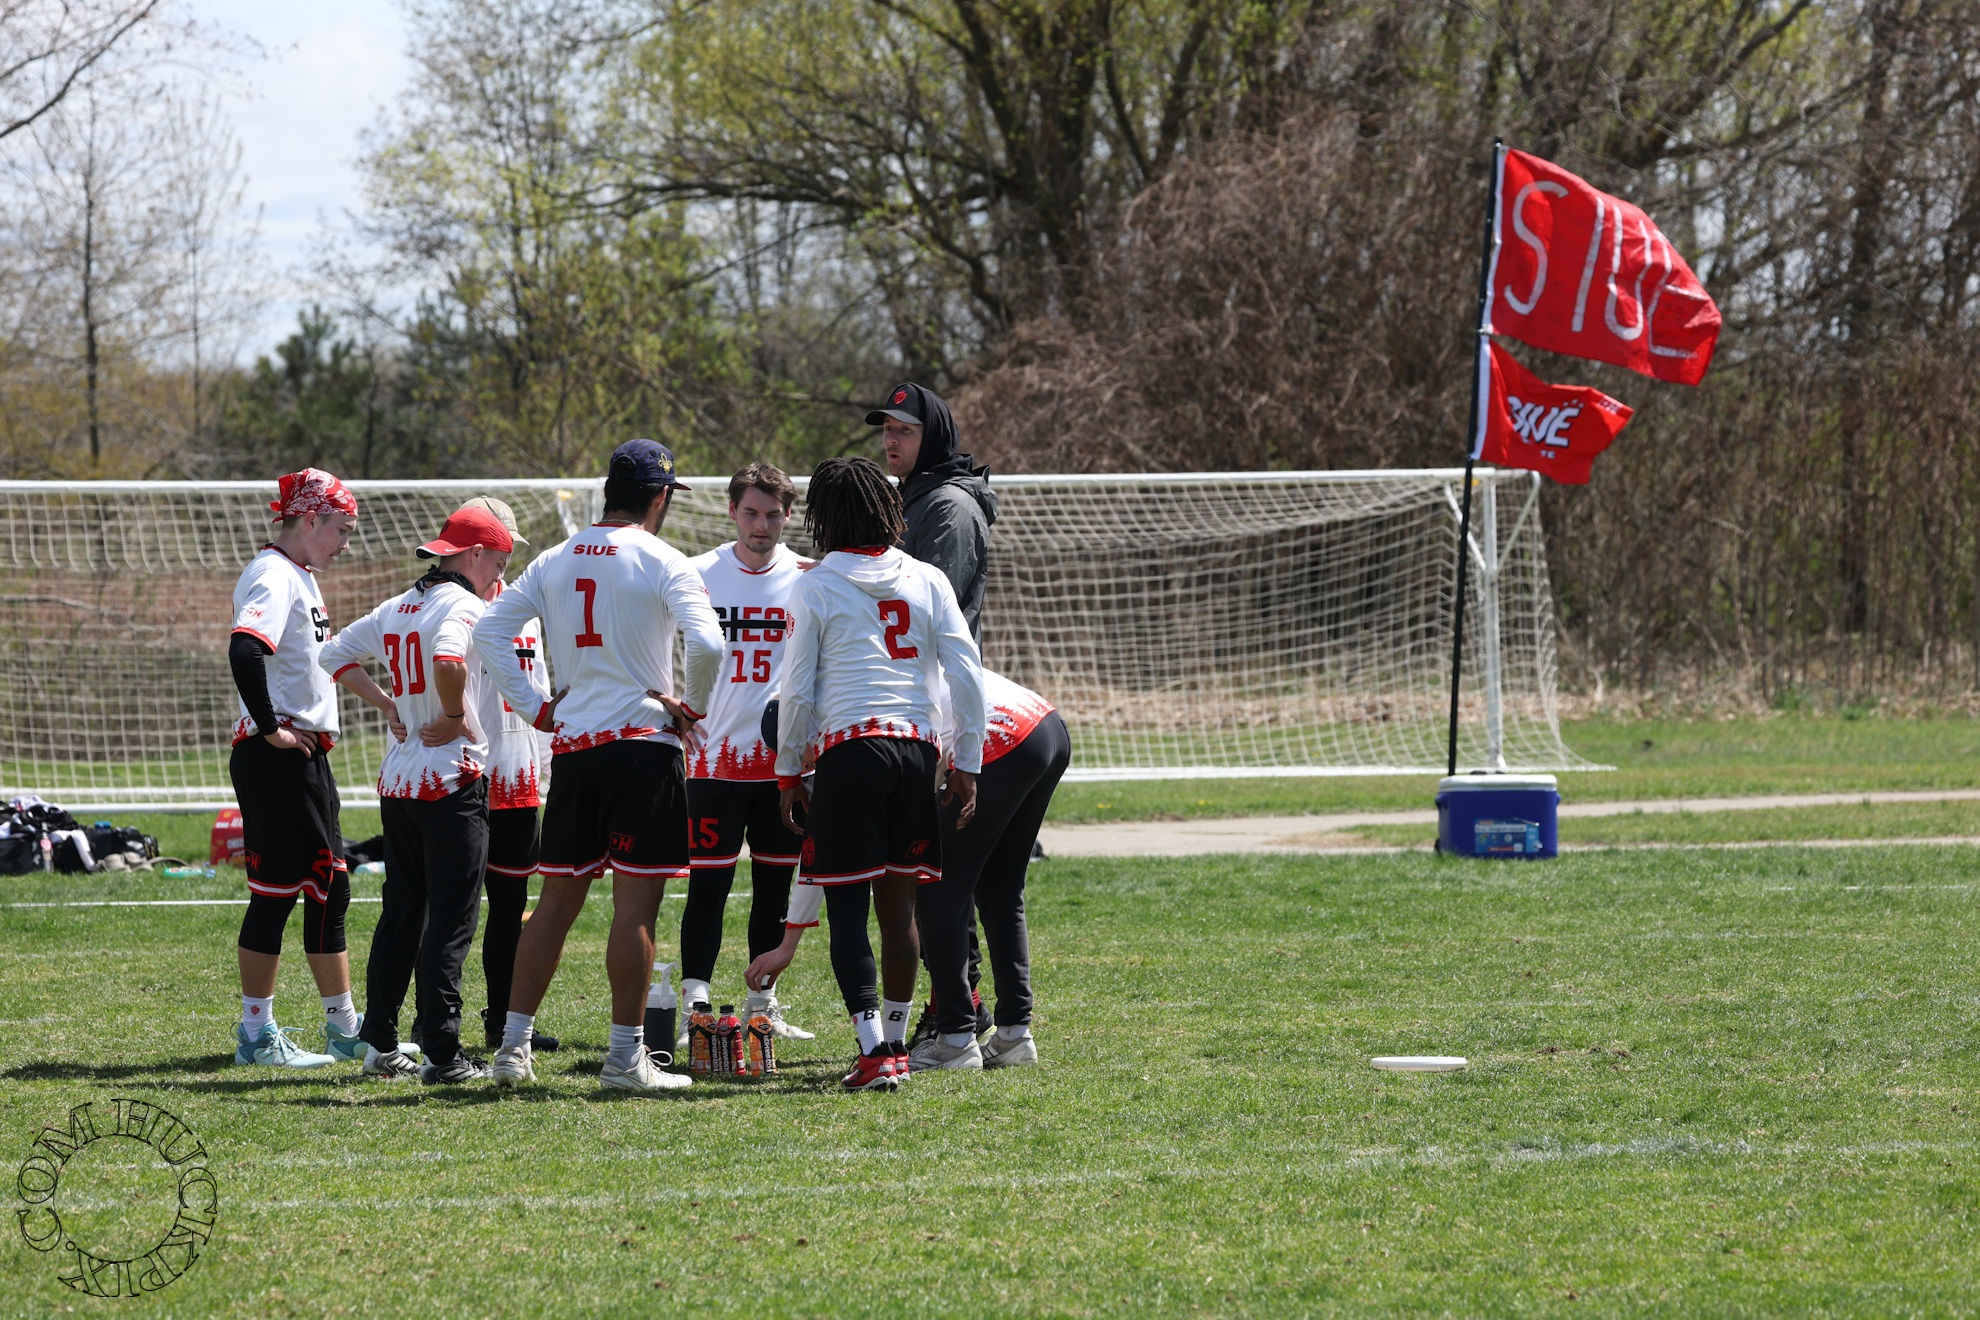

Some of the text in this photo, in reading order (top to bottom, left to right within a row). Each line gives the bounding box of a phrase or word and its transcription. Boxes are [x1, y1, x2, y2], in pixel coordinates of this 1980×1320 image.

[573, 544, 619, 557] SIUE
[574, 578, 603, 648] 1
[877, 600, 919, 661] 2
[383, 631, 426, 698] 30
[731, 649, 772, 684] 15
[688, 817, 720, 849] 15
